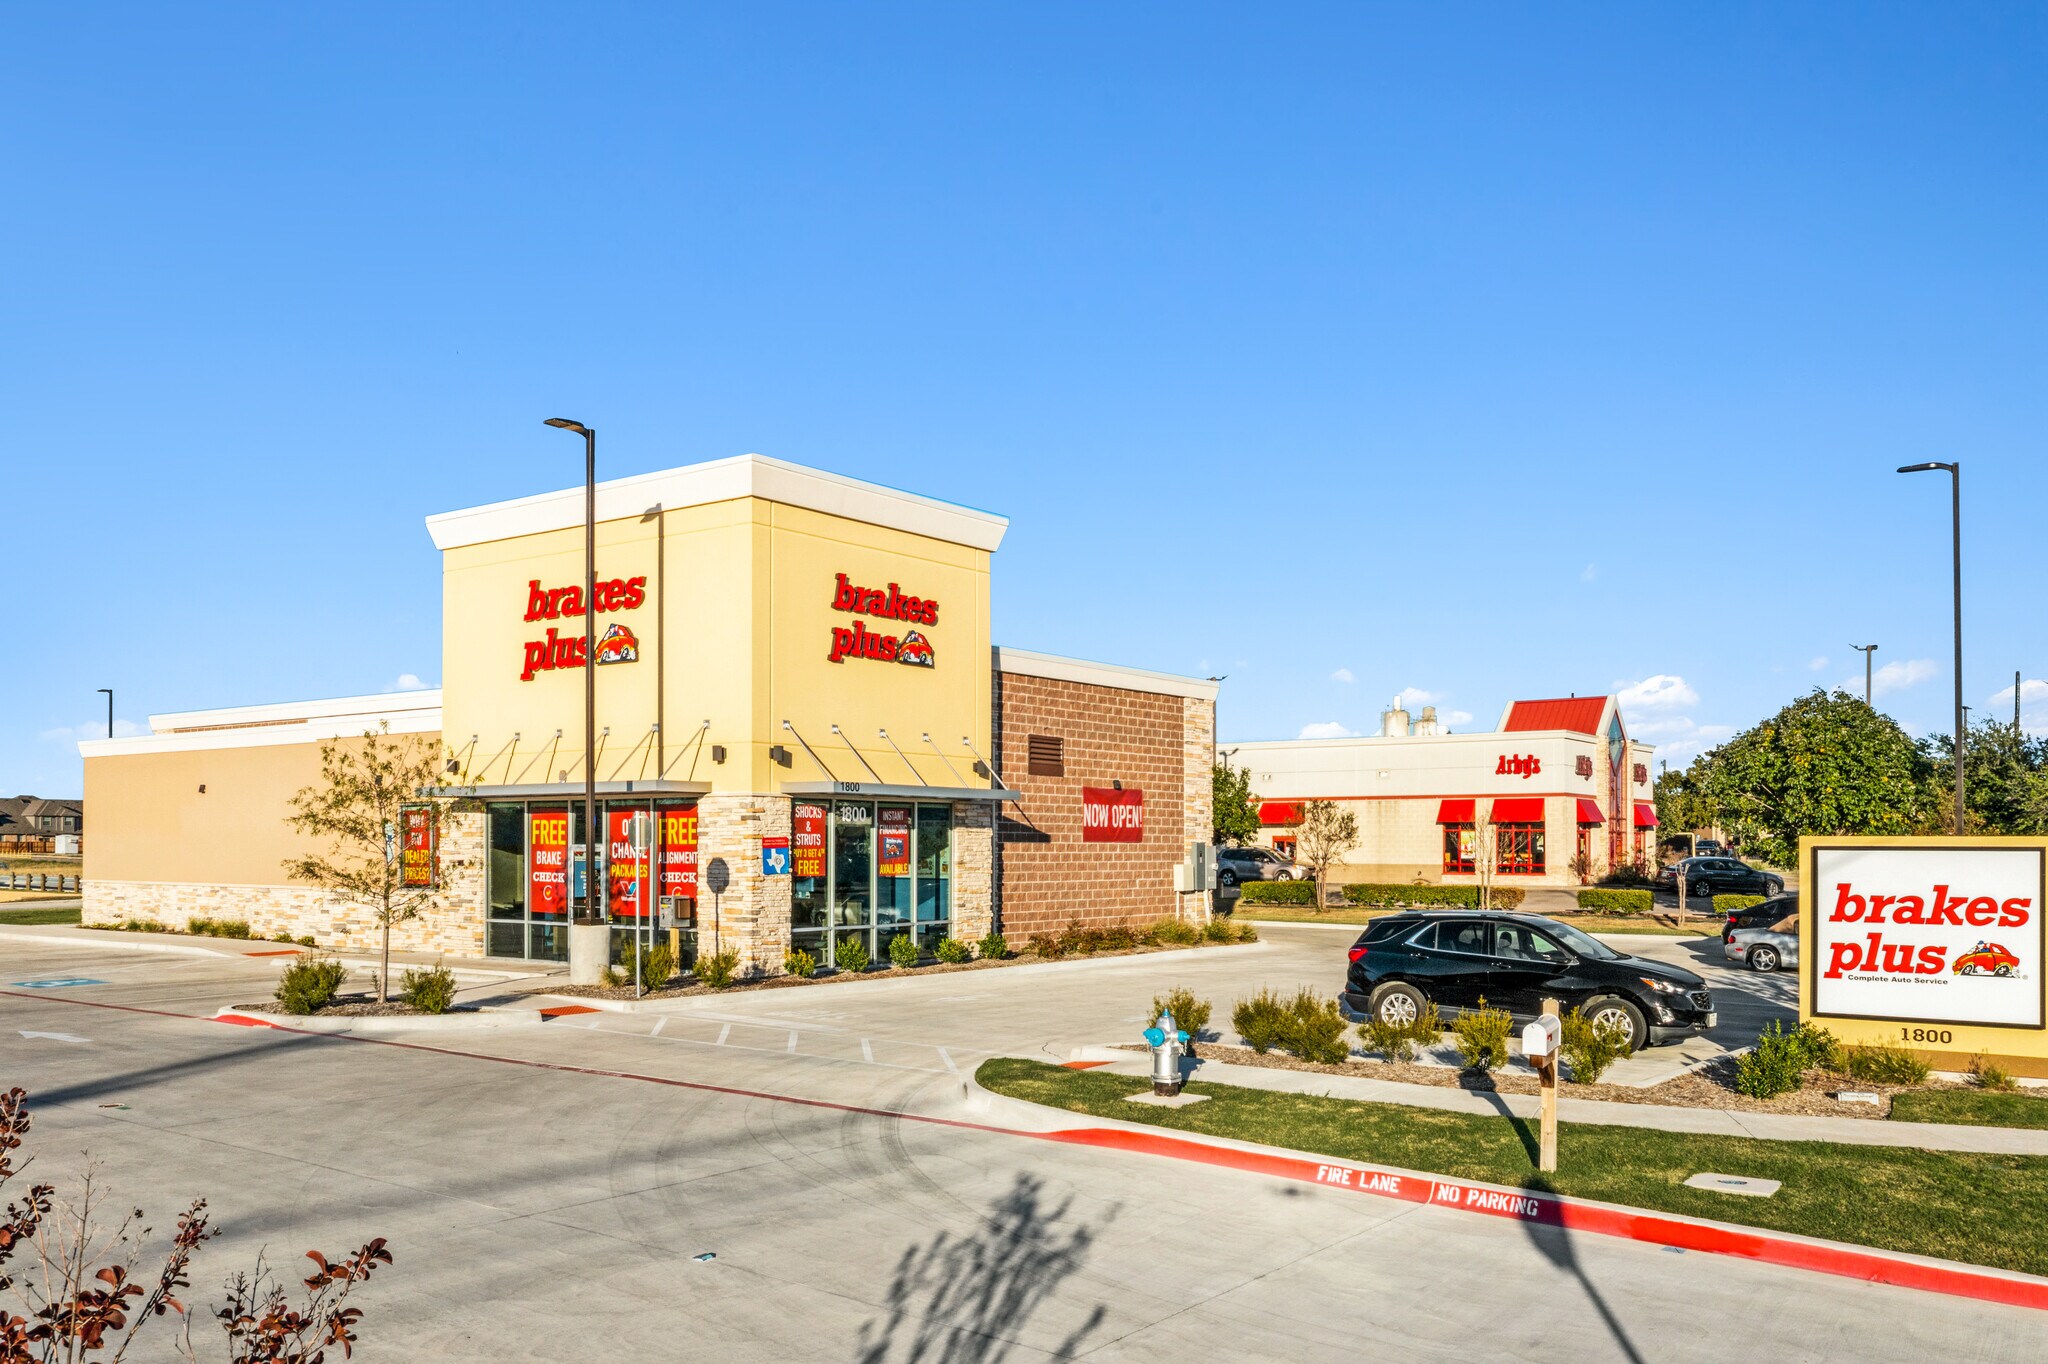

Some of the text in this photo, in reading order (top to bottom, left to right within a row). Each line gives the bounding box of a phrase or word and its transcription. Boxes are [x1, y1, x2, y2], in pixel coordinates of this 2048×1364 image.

[831, 573, 939, 626] brakes
[827, 620, 897, 664] plus
[1495, 754, 1541, 779] Arby's
[841, 782, 860, 792] 1800
[795, 806, 822, 818] SHOCKS
[840, 806, 867, 822] 1800
[882, 811, 904, 821] INSTANT
[1083, 803, 1142, 828] NOW OPEN!
[532, 819, 567, 845] FREE
[658, 817, 698, 845] FREE
[805, 820, 812, 832] &
[879, 824, 908, 835] FINANCING
[796, 834, 821, 846] STRUTS
[612, 842, 648, 859] CHANE
[803, 849, 808, 857] 3
[808, 849, 817, 858] GET
[536, 851, 562, 865] BRAKE
[658, 851, 698, 865] ALIGNMENT
[611, 864, 648, 878] PACKAES
[798, 860, 820, 875] FREE
[879, 863, 908, 875] AVAILABLE
[532, 871, 565, 883] CHECK
[660, 872, 697, 883] CHECK
[1829, 883, 2032, 928] brakes
[1823, 932, 1948, 979] plus
[1848, 974, 1889, 982] Complete
[1914, 977, 1948, 985] Service
[1901, 1027, 1952, 1043] 1800
[1316, 1165, 1401, 1194] FIRE LANE
[1437, 1184, 1539, 1217] NO PARKING
